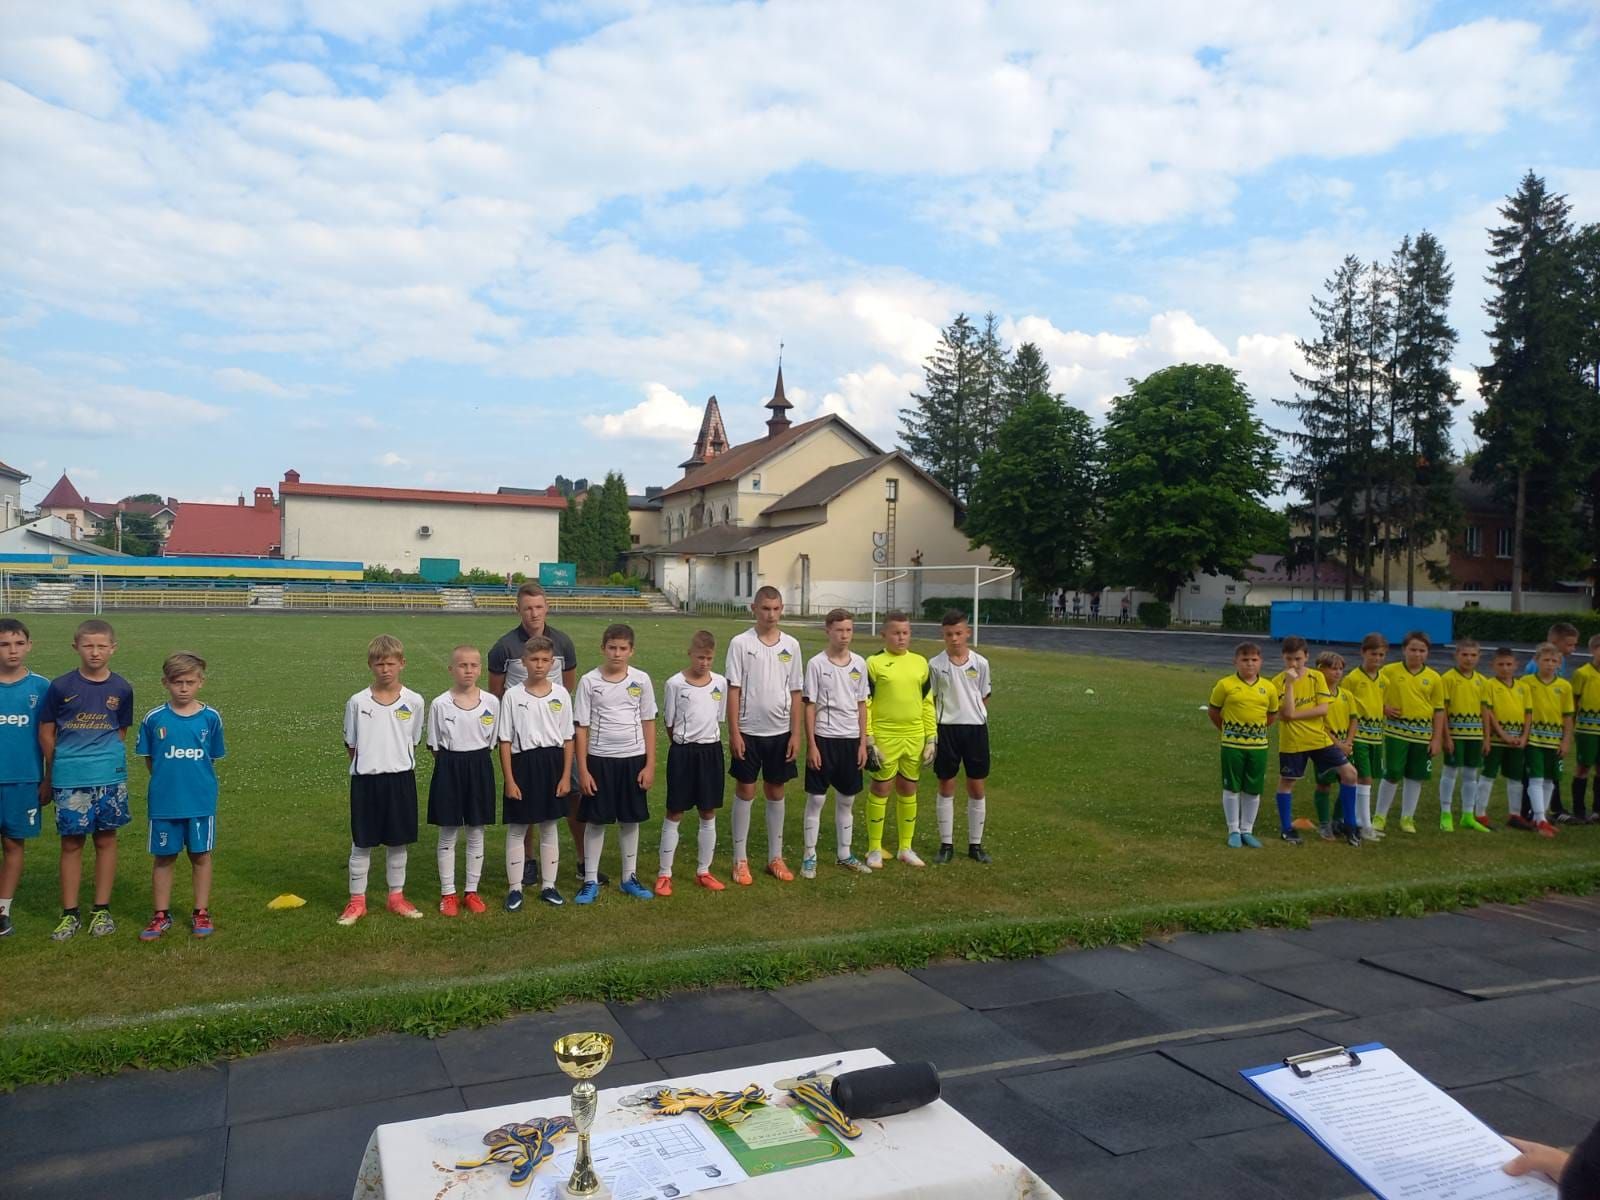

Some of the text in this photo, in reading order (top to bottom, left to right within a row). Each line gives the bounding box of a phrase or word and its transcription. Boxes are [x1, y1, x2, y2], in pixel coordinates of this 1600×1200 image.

[0, 714, 29, 728] eep
[76, 712, 108, 723] Qatar
[164, 744, 204, 761] Jeep
[27, 807, 38, 825] 7
